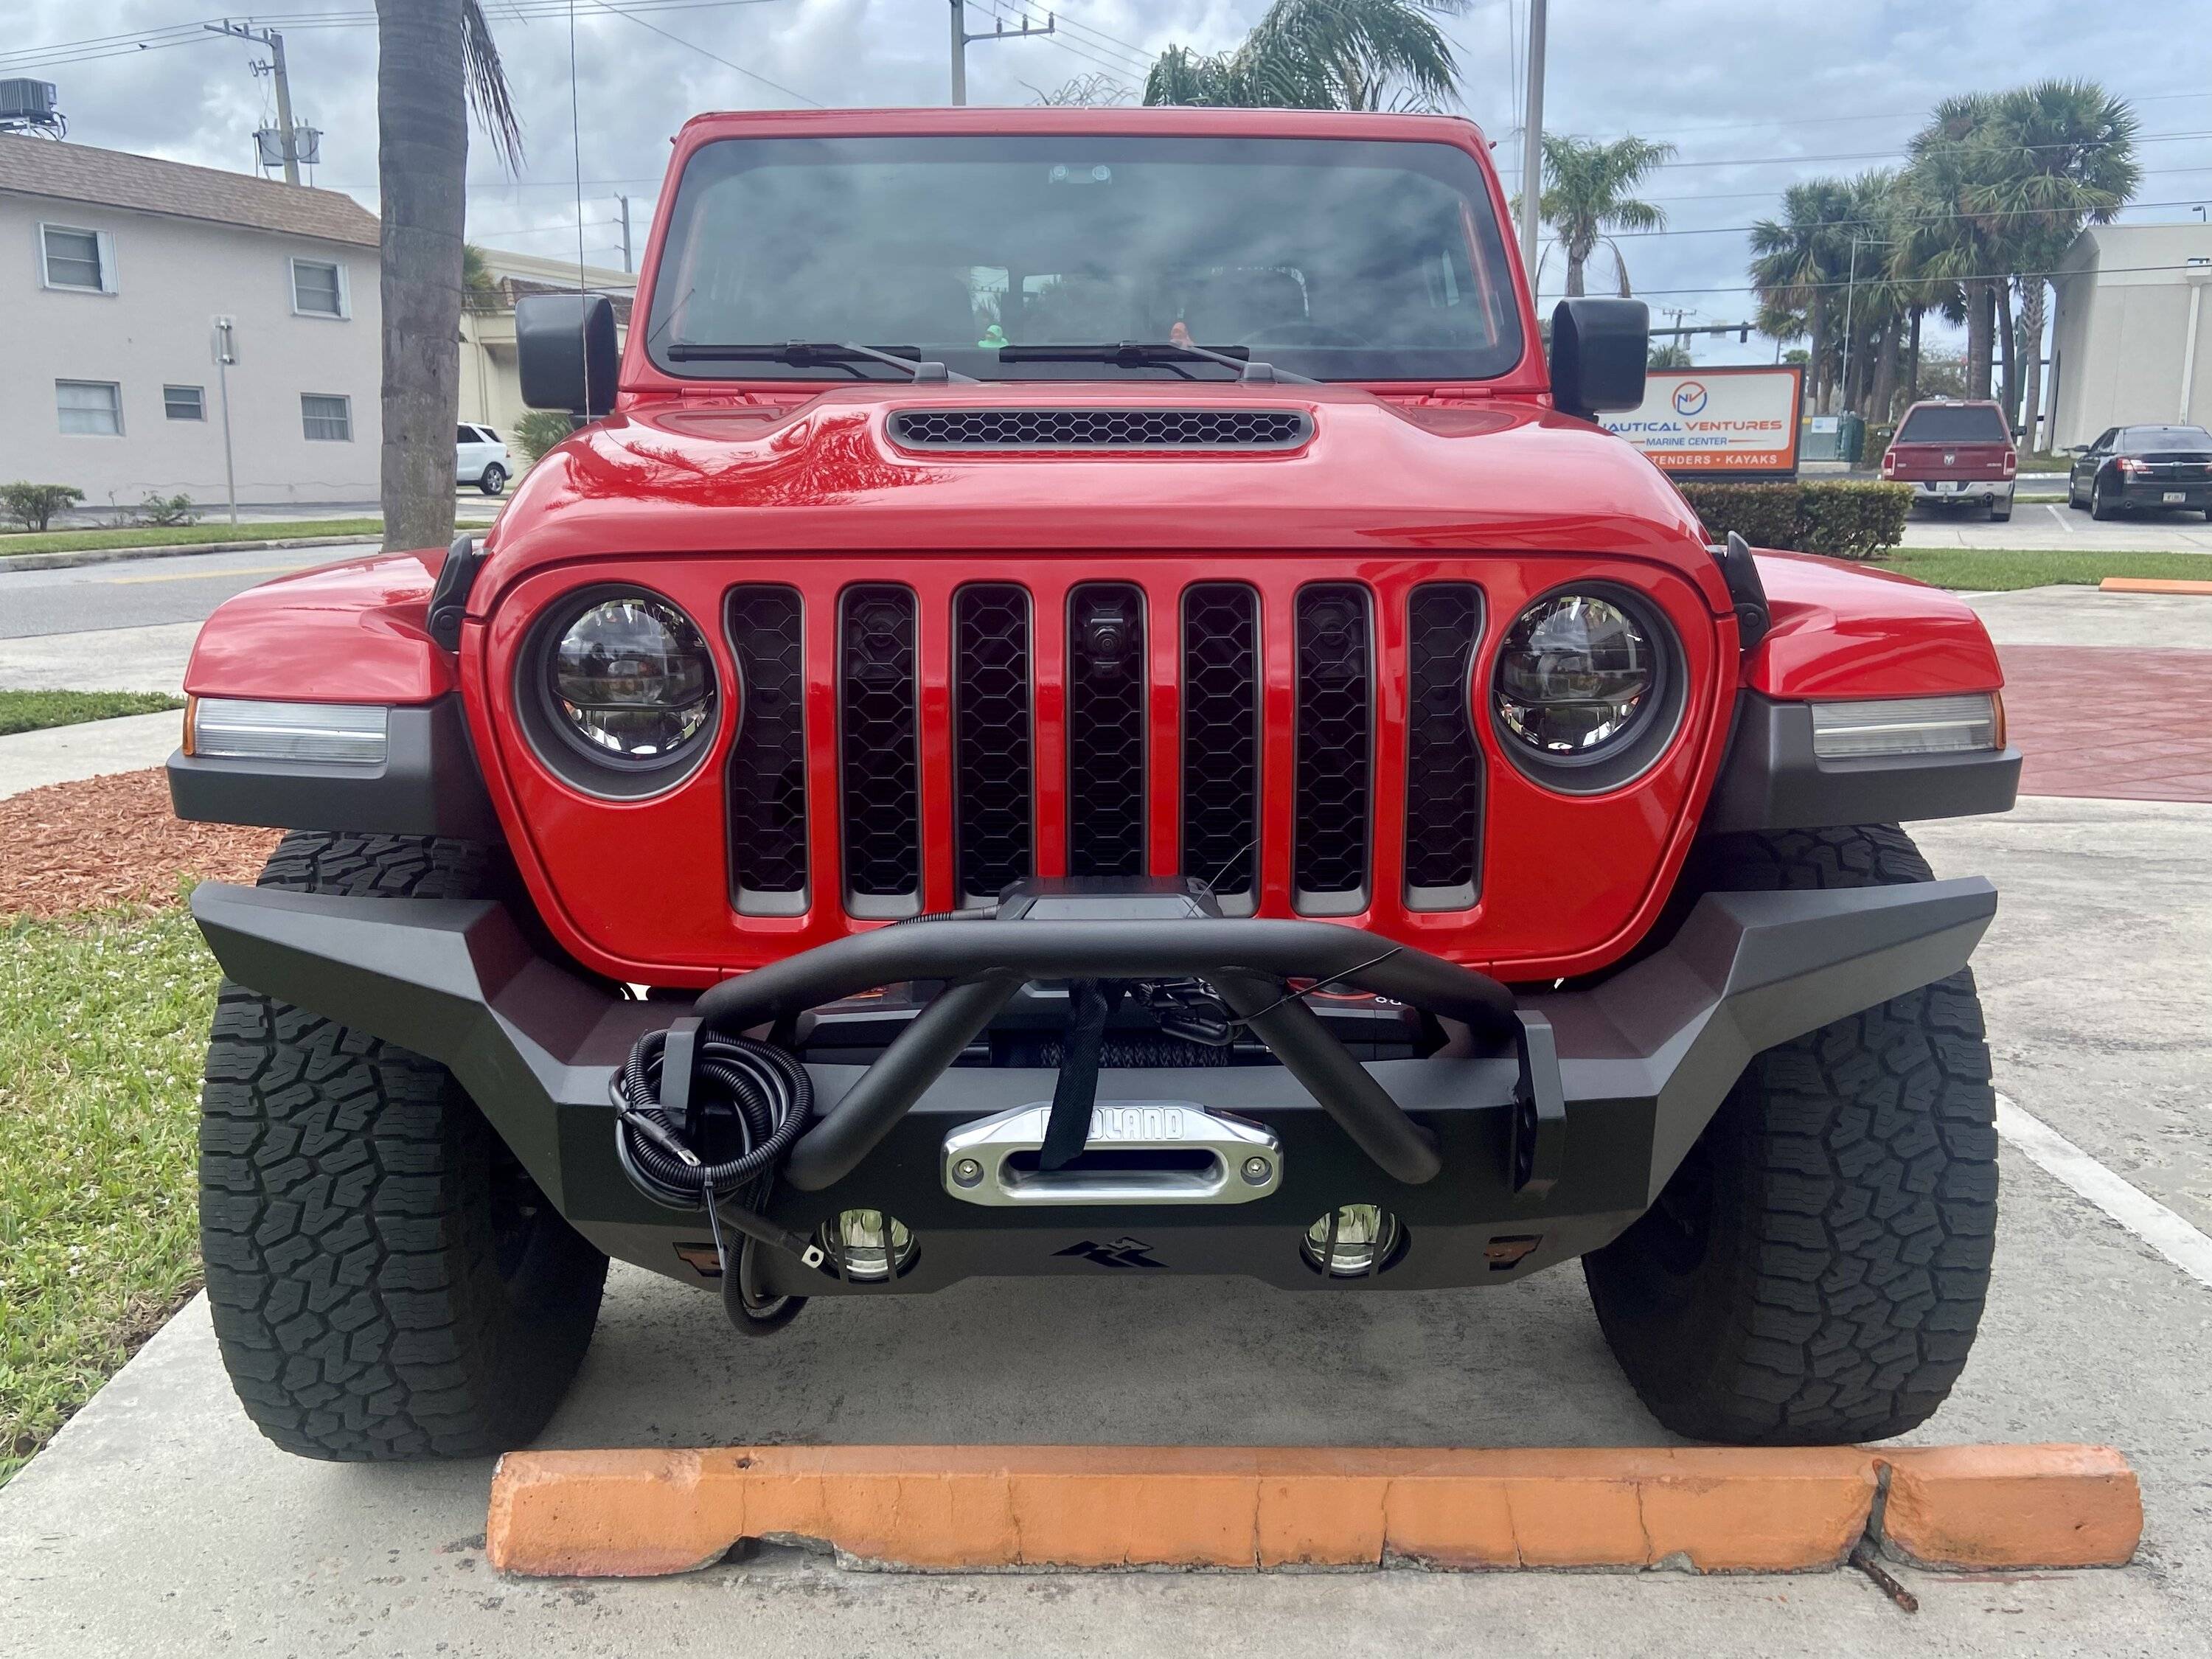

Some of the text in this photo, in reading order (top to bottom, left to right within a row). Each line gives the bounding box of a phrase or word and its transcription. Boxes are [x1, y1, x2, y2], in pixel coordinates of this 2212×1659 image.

[1604, 420, 1782, 432] AUTICAL VENTURES
[1646, 437, 1728, 446] MARINE CENTER
[1652, 454, 1778, 465] TENDERS KAYAKS
[1040, 1107, 1183, 1140] DLAND
